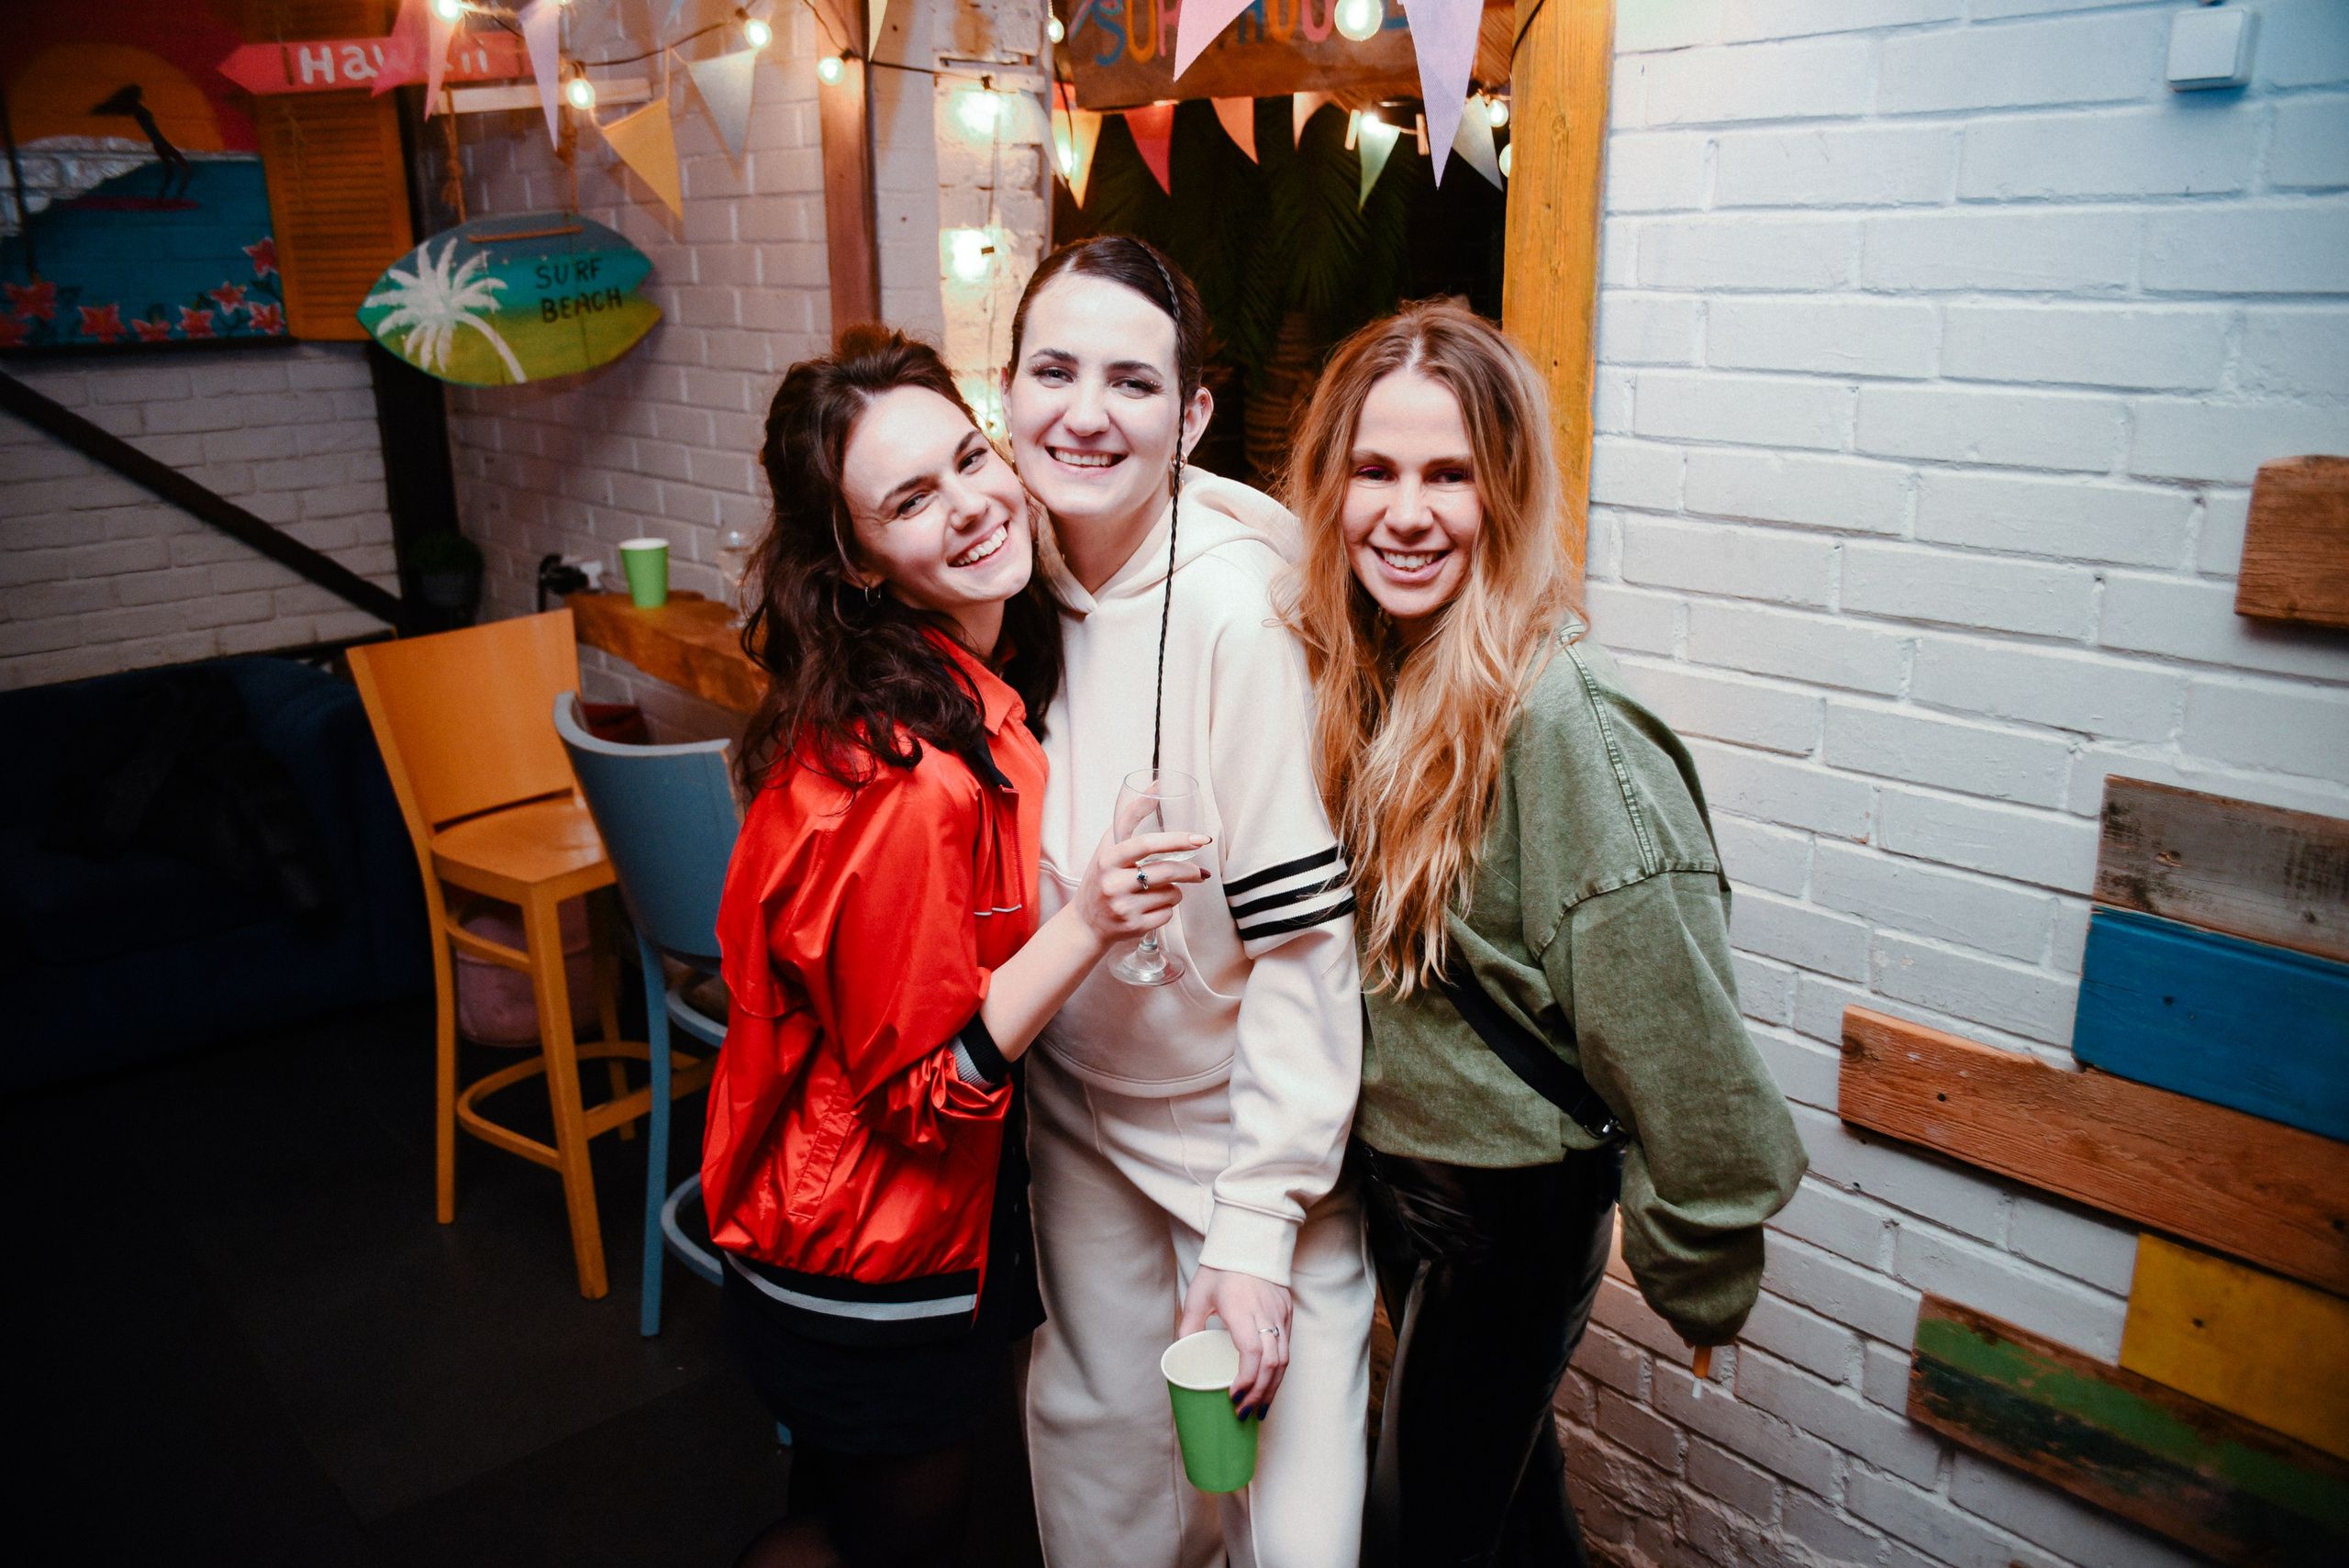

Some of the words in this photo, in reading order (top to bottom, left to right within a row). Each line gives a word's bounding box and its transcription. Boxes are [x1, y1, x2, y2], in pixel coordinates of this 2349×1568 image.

[300, 40, 489, 84] Haii
[535, 257, 602, 290] SURF
[540, 284, 623, 324] BEACH
